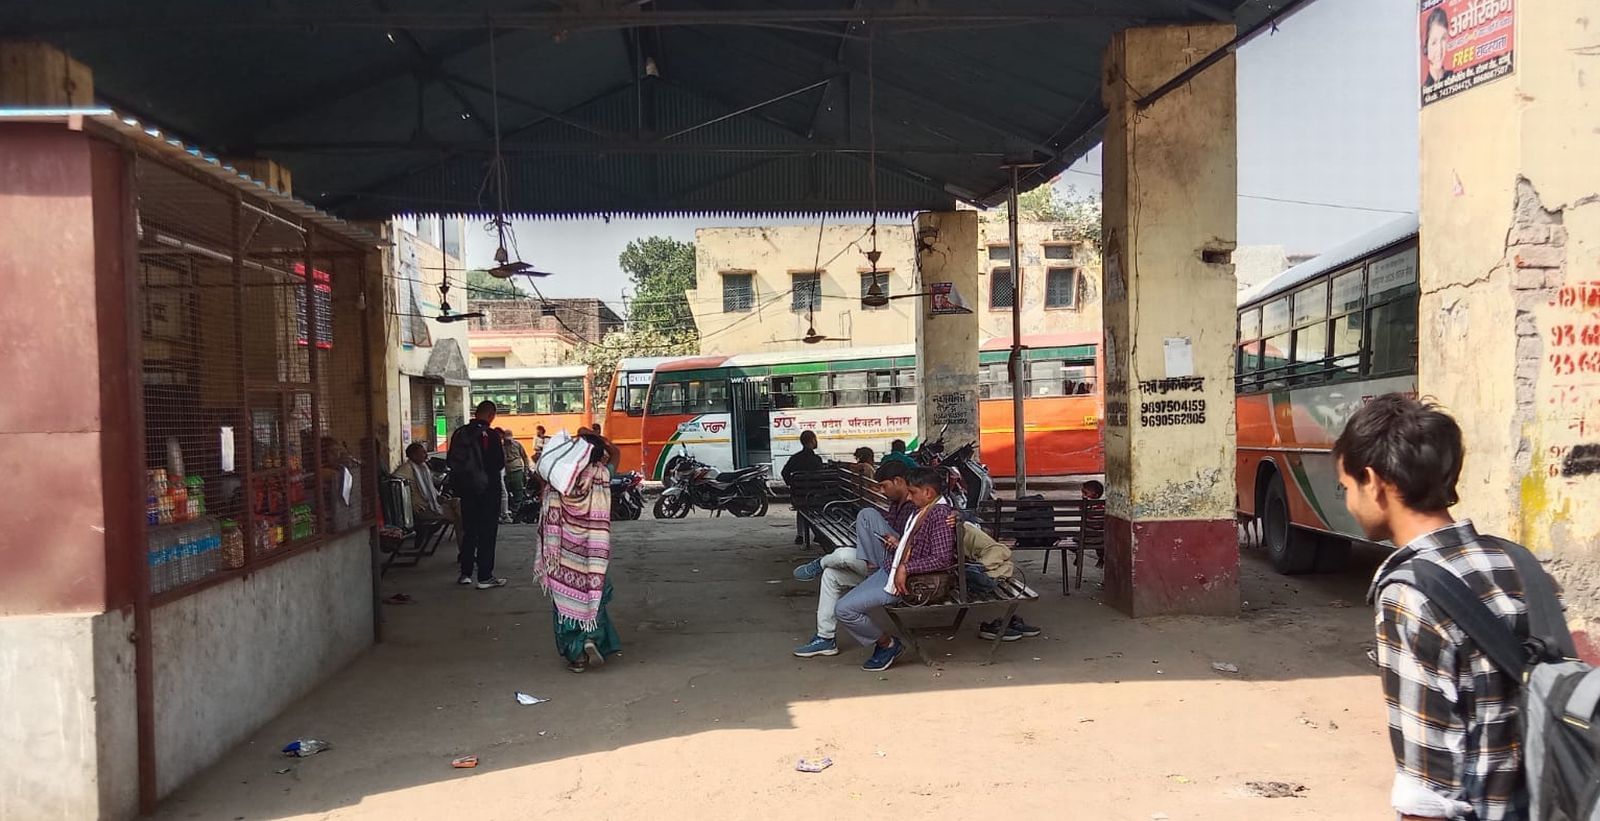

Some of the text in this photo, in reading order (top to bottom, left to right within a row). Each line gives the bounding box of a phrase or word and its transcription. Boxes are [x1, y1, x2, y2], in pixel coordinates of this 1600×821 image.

[1452, 45, 1476, 68] FREE
[1141, 400, 1206, 413] 9897504159
[886, 415, 912, 426] निगम
[1141, 412, 1206, 427] 9690562805
